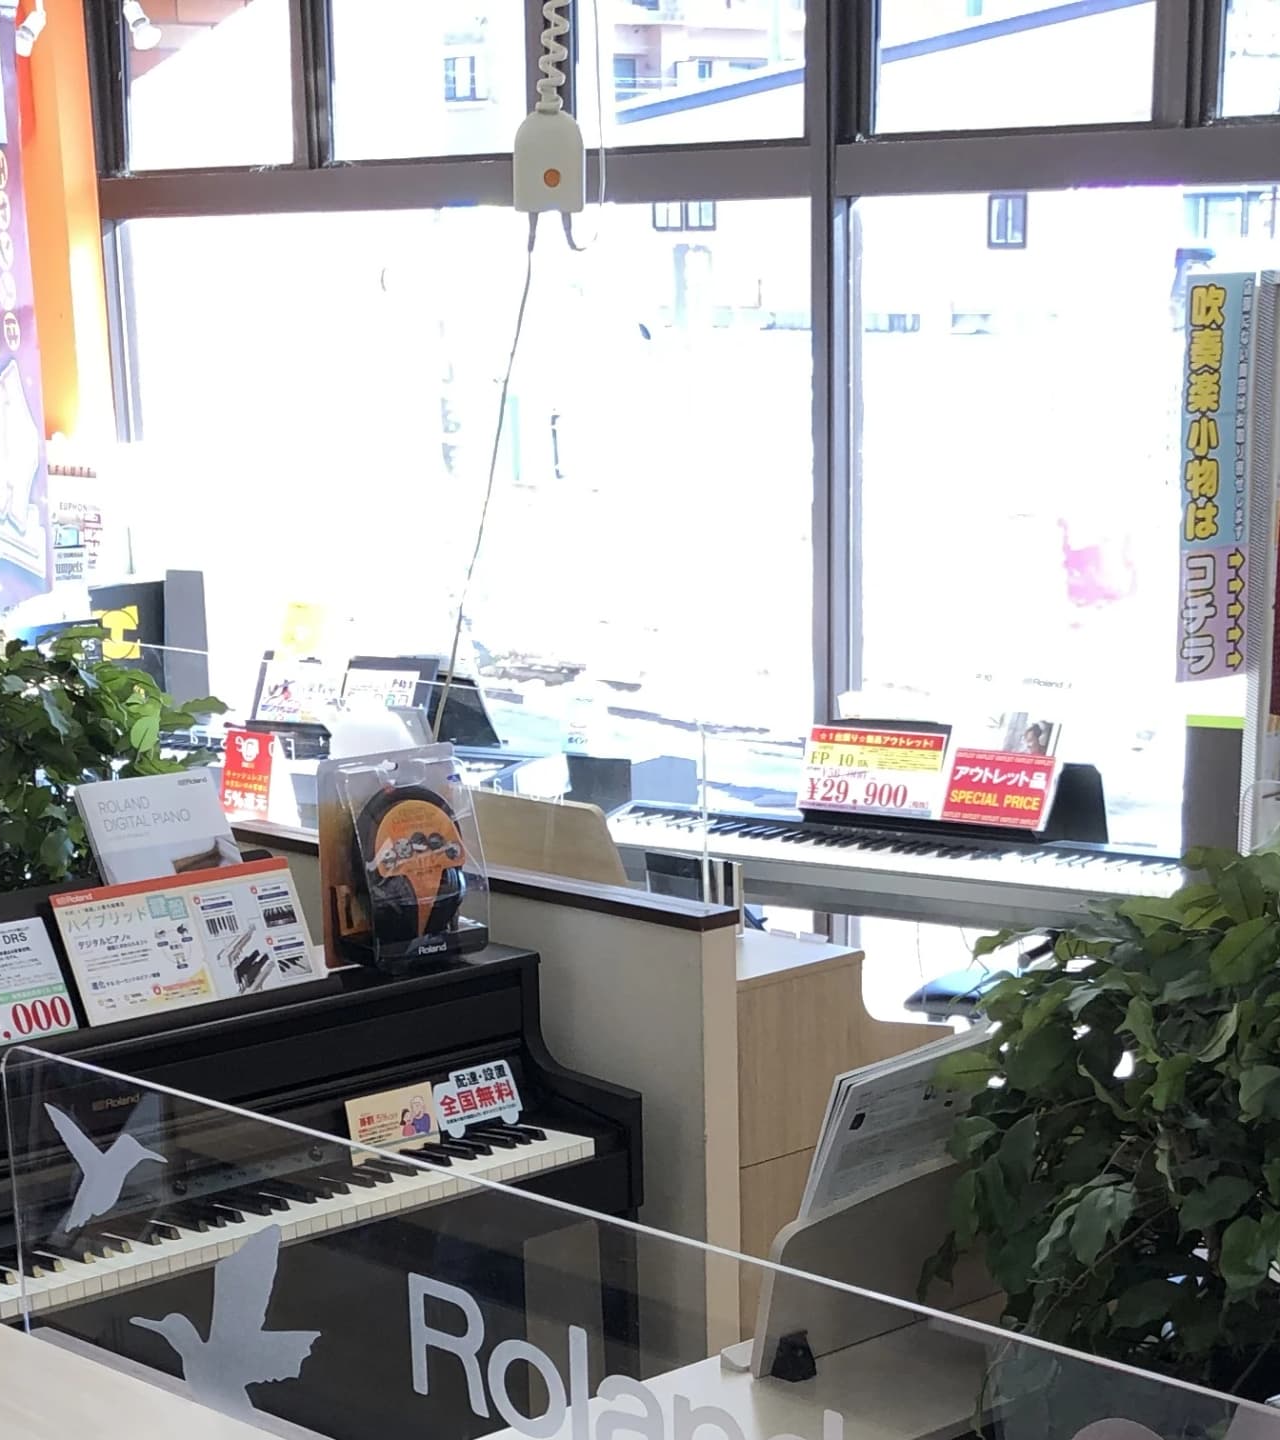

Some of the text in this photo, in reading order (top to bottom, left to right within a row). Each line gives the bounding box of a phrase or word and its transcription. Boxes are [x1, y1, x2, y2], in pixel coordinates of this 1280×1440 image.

[1183, 283, 1226, 541] 吹奏楽小物は
[1178, 554, 1218, 676] コチラ
[951, 764, 1048, 792] アウトレット品
[96, 795, 151, 814] ROLAND
[949, 788, 1041, 811] SPECIAL PRICE
[102, 808, 192, 833] DIGITAL PIANO
[68, 906, 147, 933] ハイブリッド
[1, 931, 29, 946] DRS
[417, 941, 448, 955] Roland
[454, 1063, 508, 1089] 配達・設置
[439, 1079, 516, 1118] 全国無料
